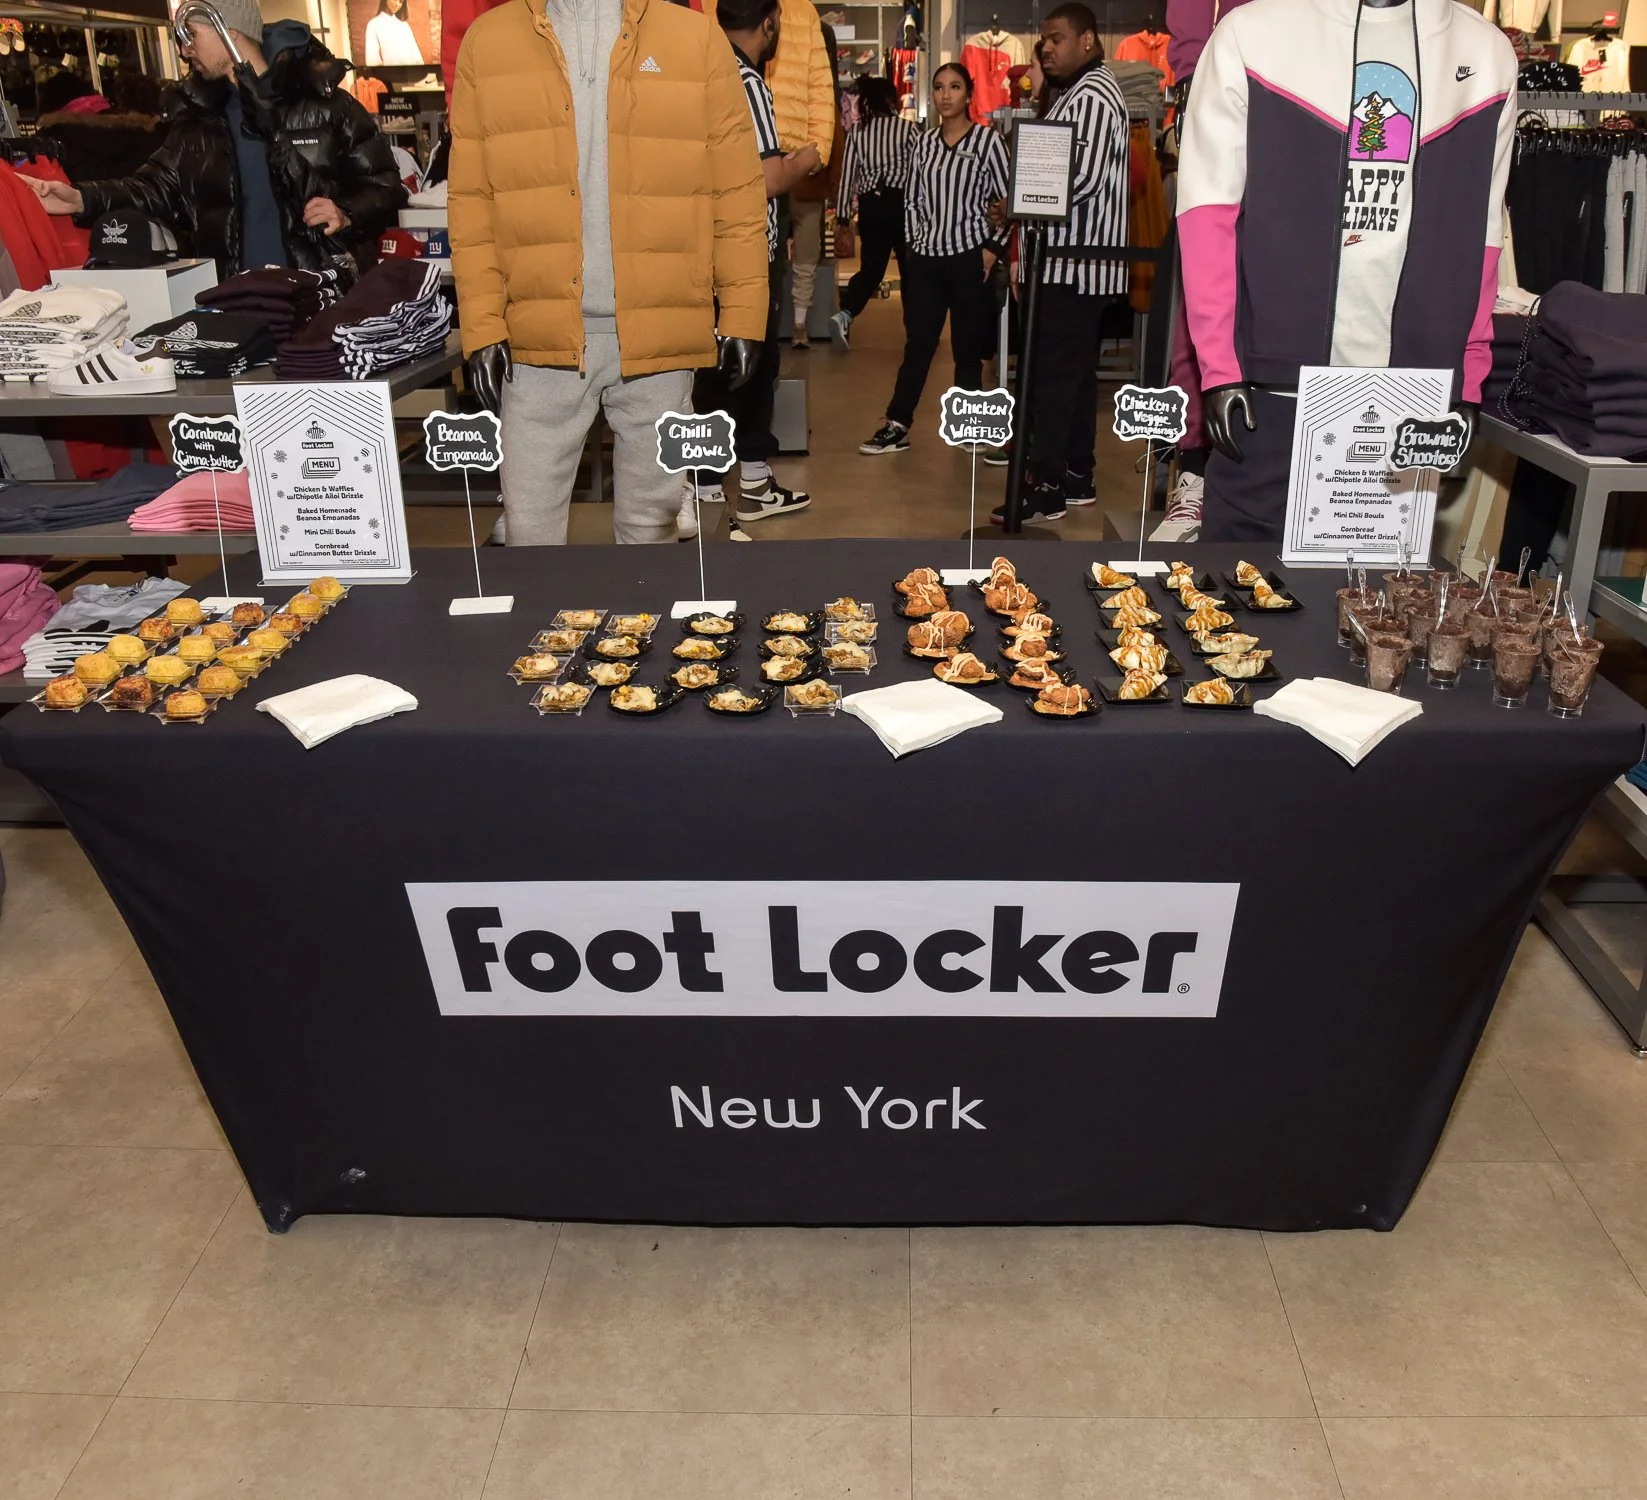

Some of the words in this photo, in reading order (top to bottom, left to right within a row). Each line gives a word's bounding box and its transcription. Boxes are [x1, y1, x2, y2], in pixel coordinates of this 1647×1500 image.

[1343, 168, 1406, 205] APPY
[1037, 195, 1058, 203] Locker
[1342, 205, 1400, 232] LIDAYS
[1133, 410, 1172, 427] Veggie
[179, 422, 237, 444] Cornbread
[437, 423, 487, 444] Beanoa
[668, 423, 712, 439] Chilli
[1120, 419, 1179, 439] Dumplings
[1398, 423, 1457, 447] Brownie
[194, 441, 215, 452] with
[432, 444, 495, 464] Empanada
[1358, 445, 1381, 453] MENU
[1395, 446, 1458, 466] Shooters
[1325, 476, 1361, 484] w/Chipotle
[286, 492, 324, 501] w/Chipotle
[322, 514, 360, 522] Empanadas
[446, 906, 724, 993] Foot
[767, 905, 1199, 993] Locker
[670, 1086, 822, 1130] New
[844, 1086, 987, 1130] York
